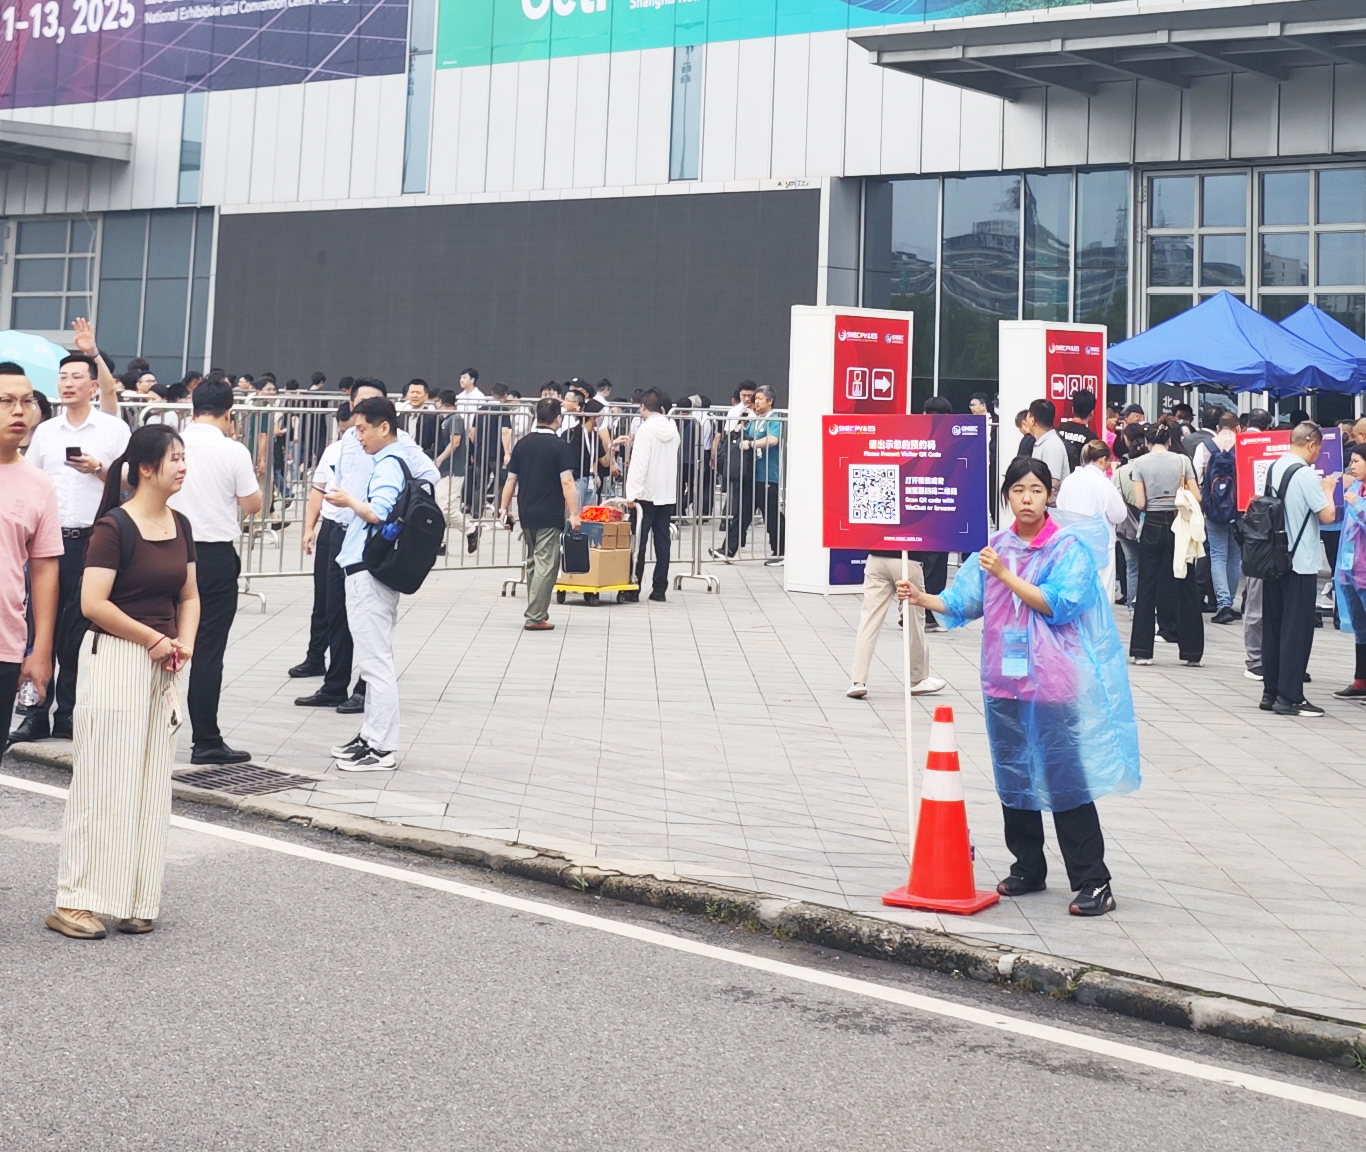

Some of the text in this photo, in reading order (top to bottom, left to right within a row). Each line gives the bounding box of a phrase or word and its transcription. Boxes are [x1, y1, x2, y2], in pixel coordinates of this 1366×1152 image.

[144, 8, 179, 24] National
[179, 4, 221, 21] Exhibition
[221, 1, 238, 16] and
